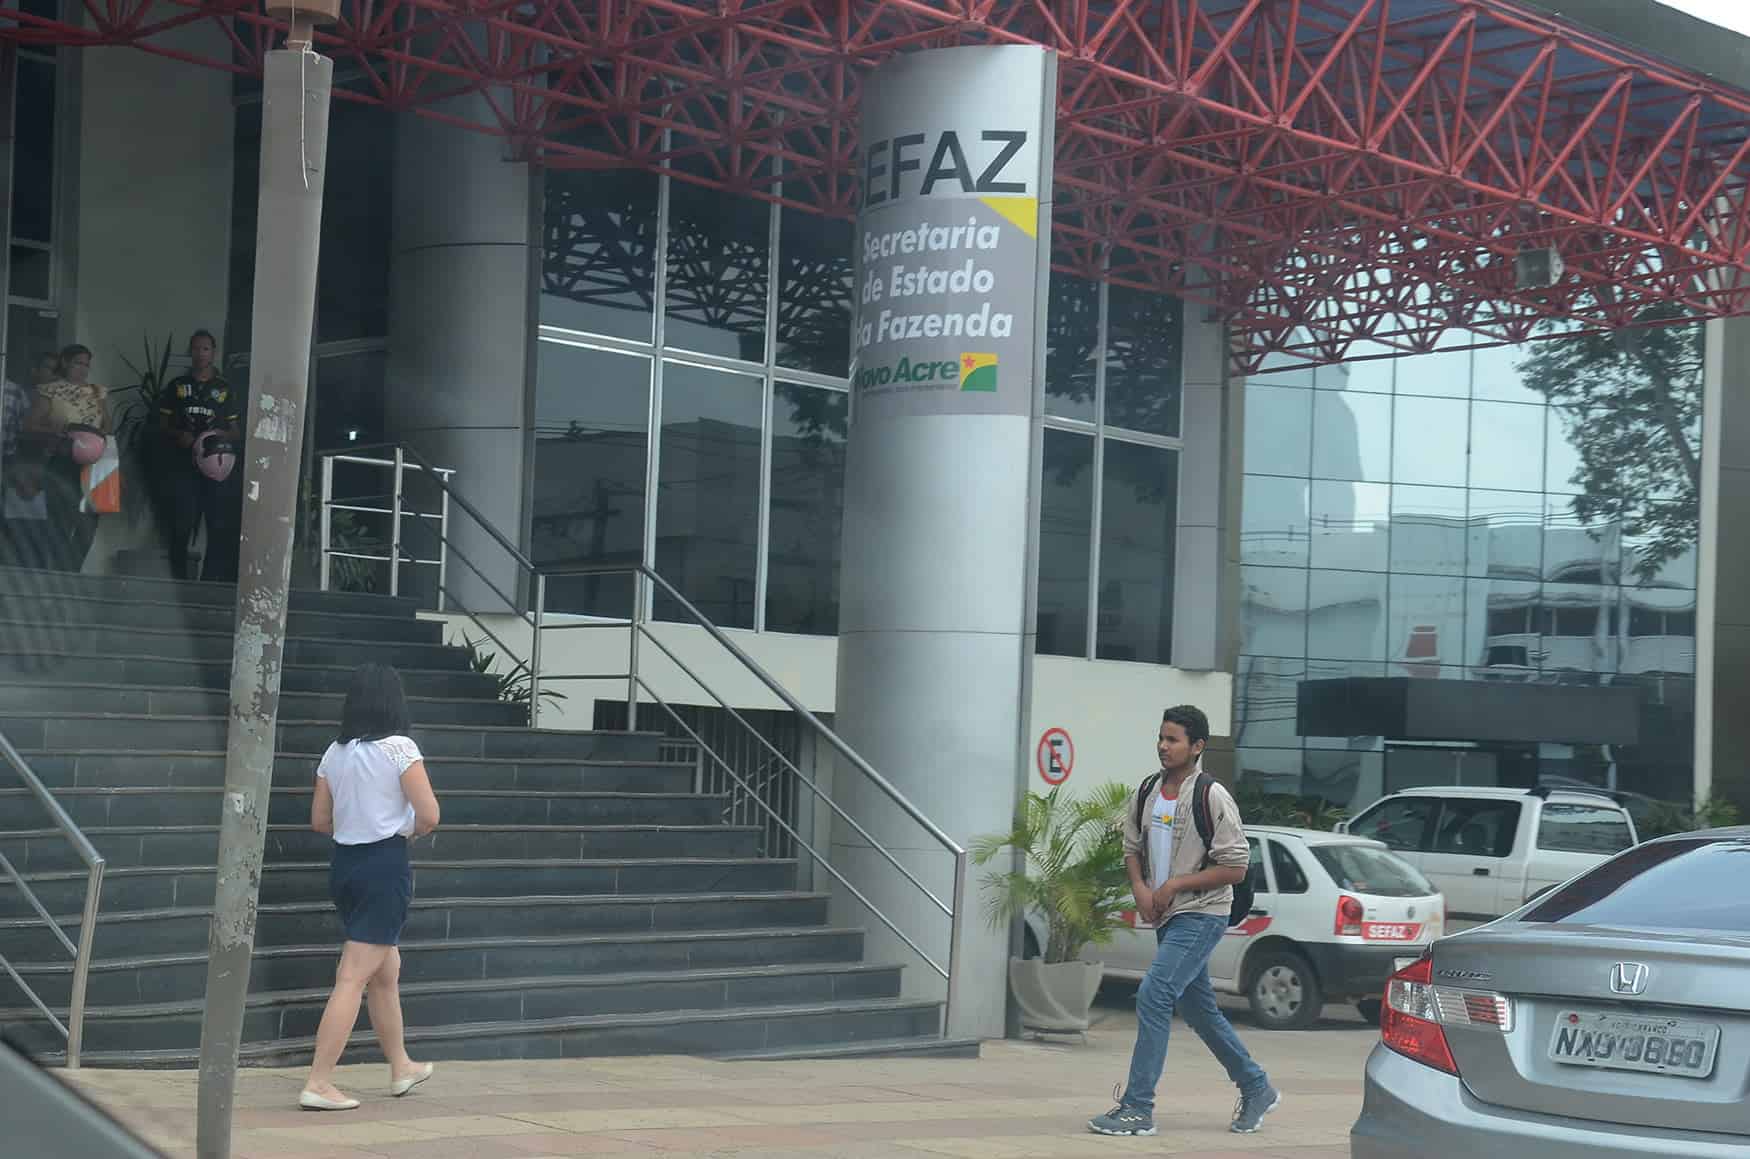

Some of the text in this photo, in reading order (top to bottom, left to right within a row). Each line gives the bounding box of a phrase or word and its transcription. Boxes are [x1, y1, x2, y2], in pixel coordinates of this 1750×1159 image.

[865, 130, 1027, 208] EFAZ
[863, 216, 1000, 263] Secretaria
[862, 259, 994, 304] de Estado
[877, 303, 1013, 343] Fazenda
[893, 356, 959, 382] Acre
[1368, 925, 1406, 938] SEFAZ
